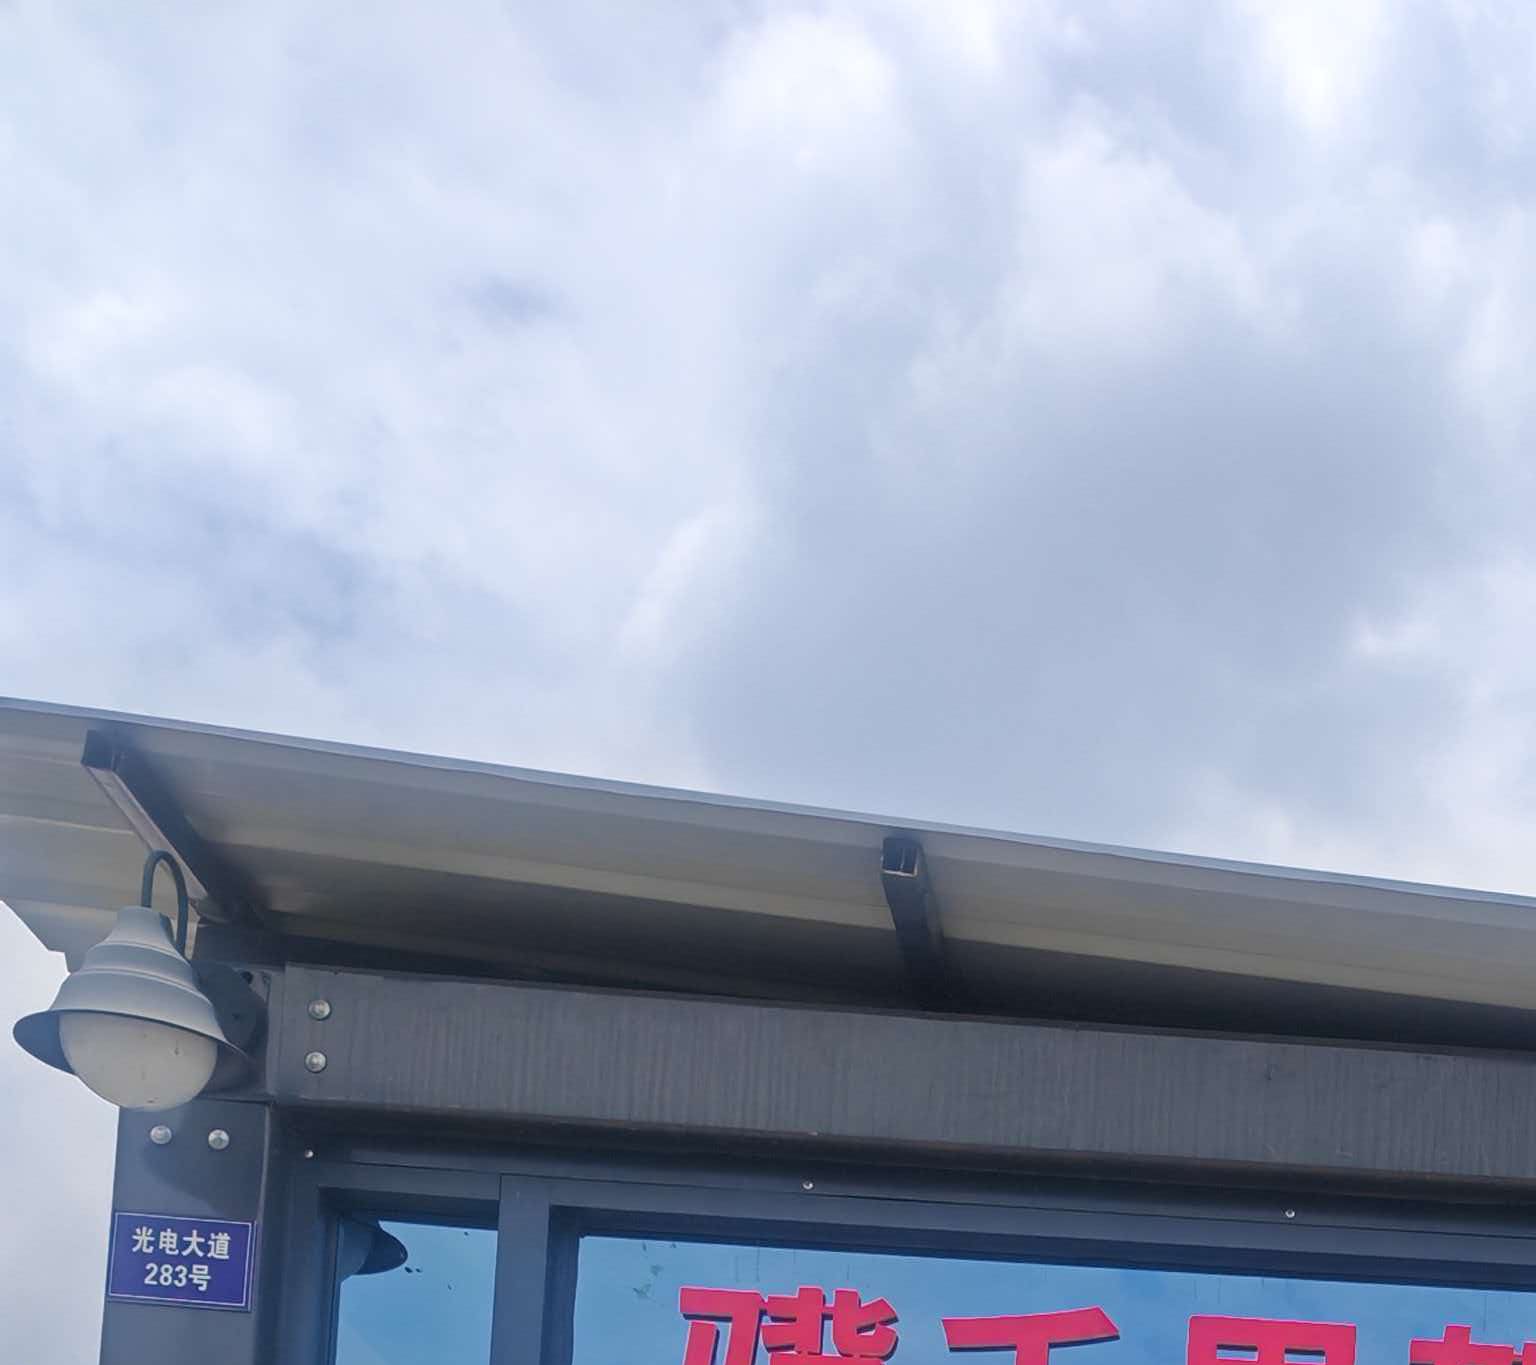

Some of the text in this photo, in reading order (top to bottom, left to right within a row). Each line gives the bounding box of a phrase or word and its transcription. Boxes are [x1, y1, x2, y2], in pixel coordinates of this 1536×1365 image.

[131, 1225, 231, 1260] 光电大道
[143, 1263, 211, 1291] 283号
